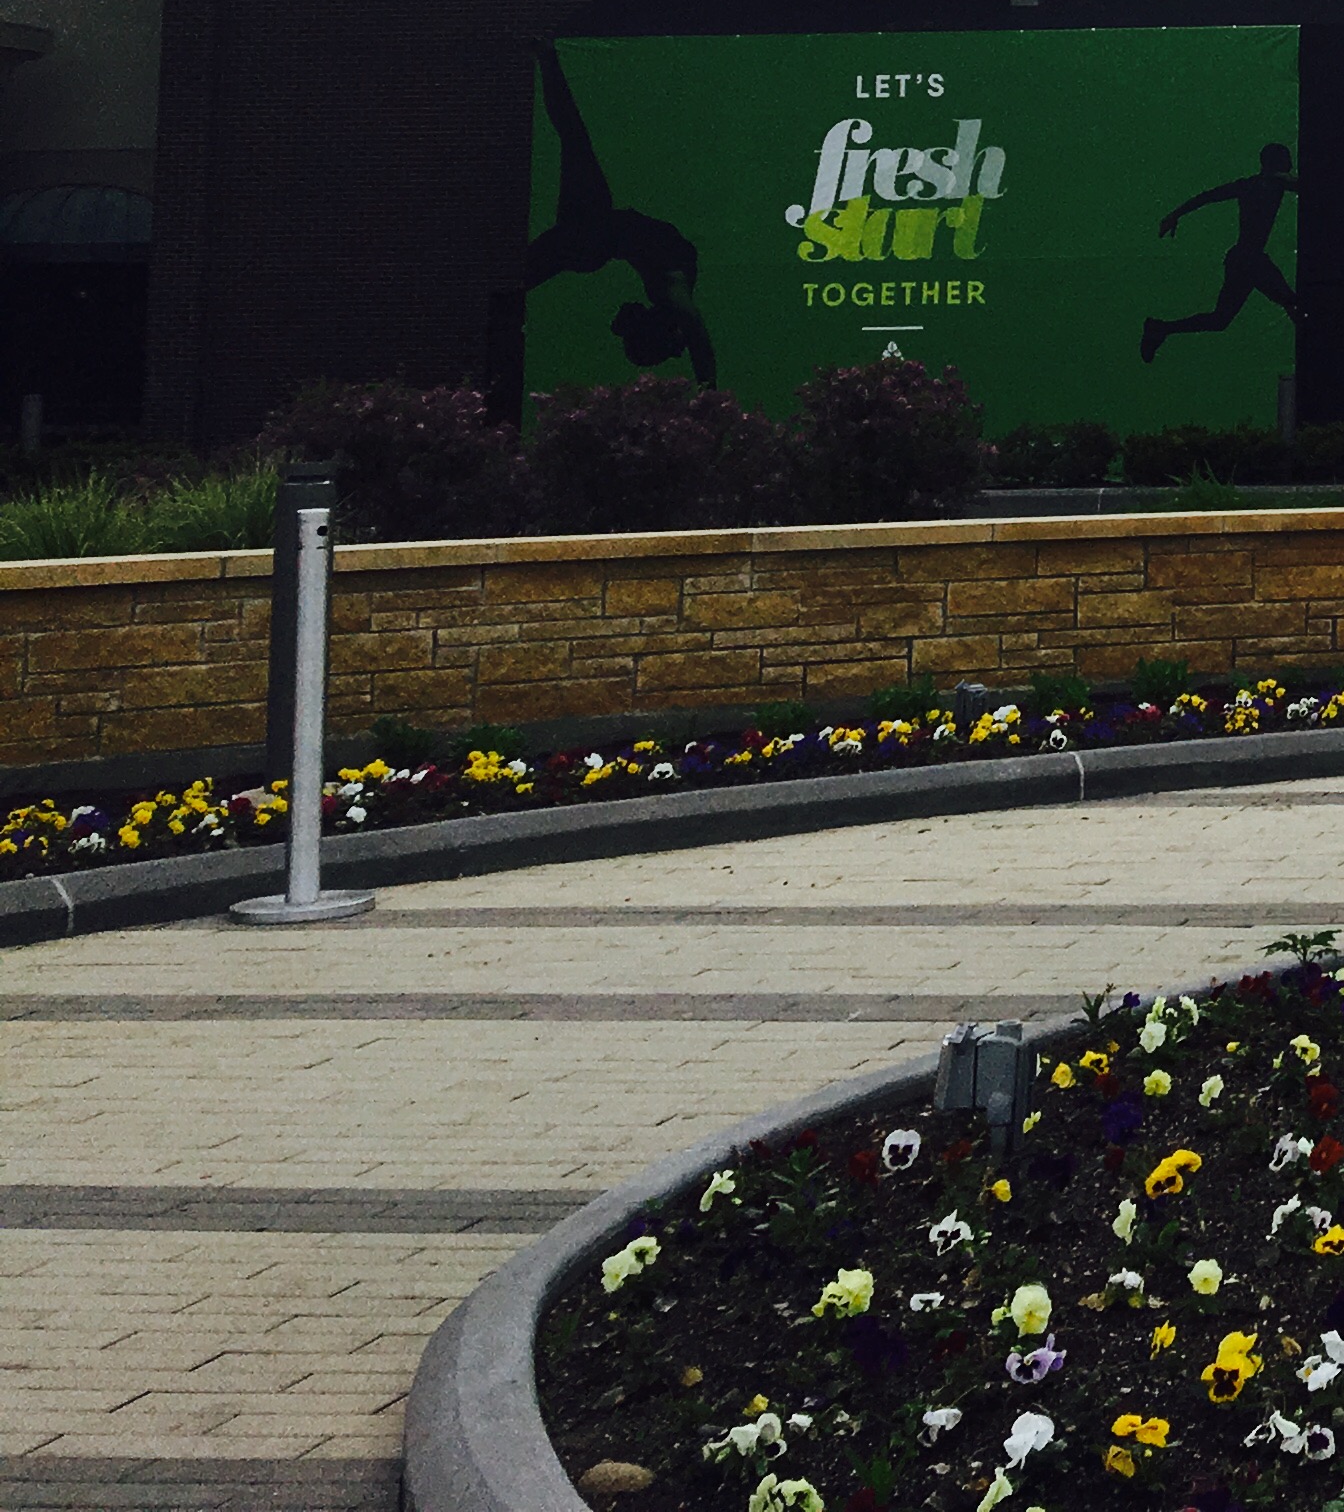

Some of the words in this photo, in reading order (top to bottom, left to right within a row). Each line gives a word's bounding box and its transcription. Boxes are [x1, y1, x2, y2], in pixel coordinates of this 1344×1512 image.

[855, 73, 946, 99] LET'S
[784, 118, 1008, 228] fresh
[796, 193, 989, 262] start
[802, 280, 986, 307] TOGETHER
